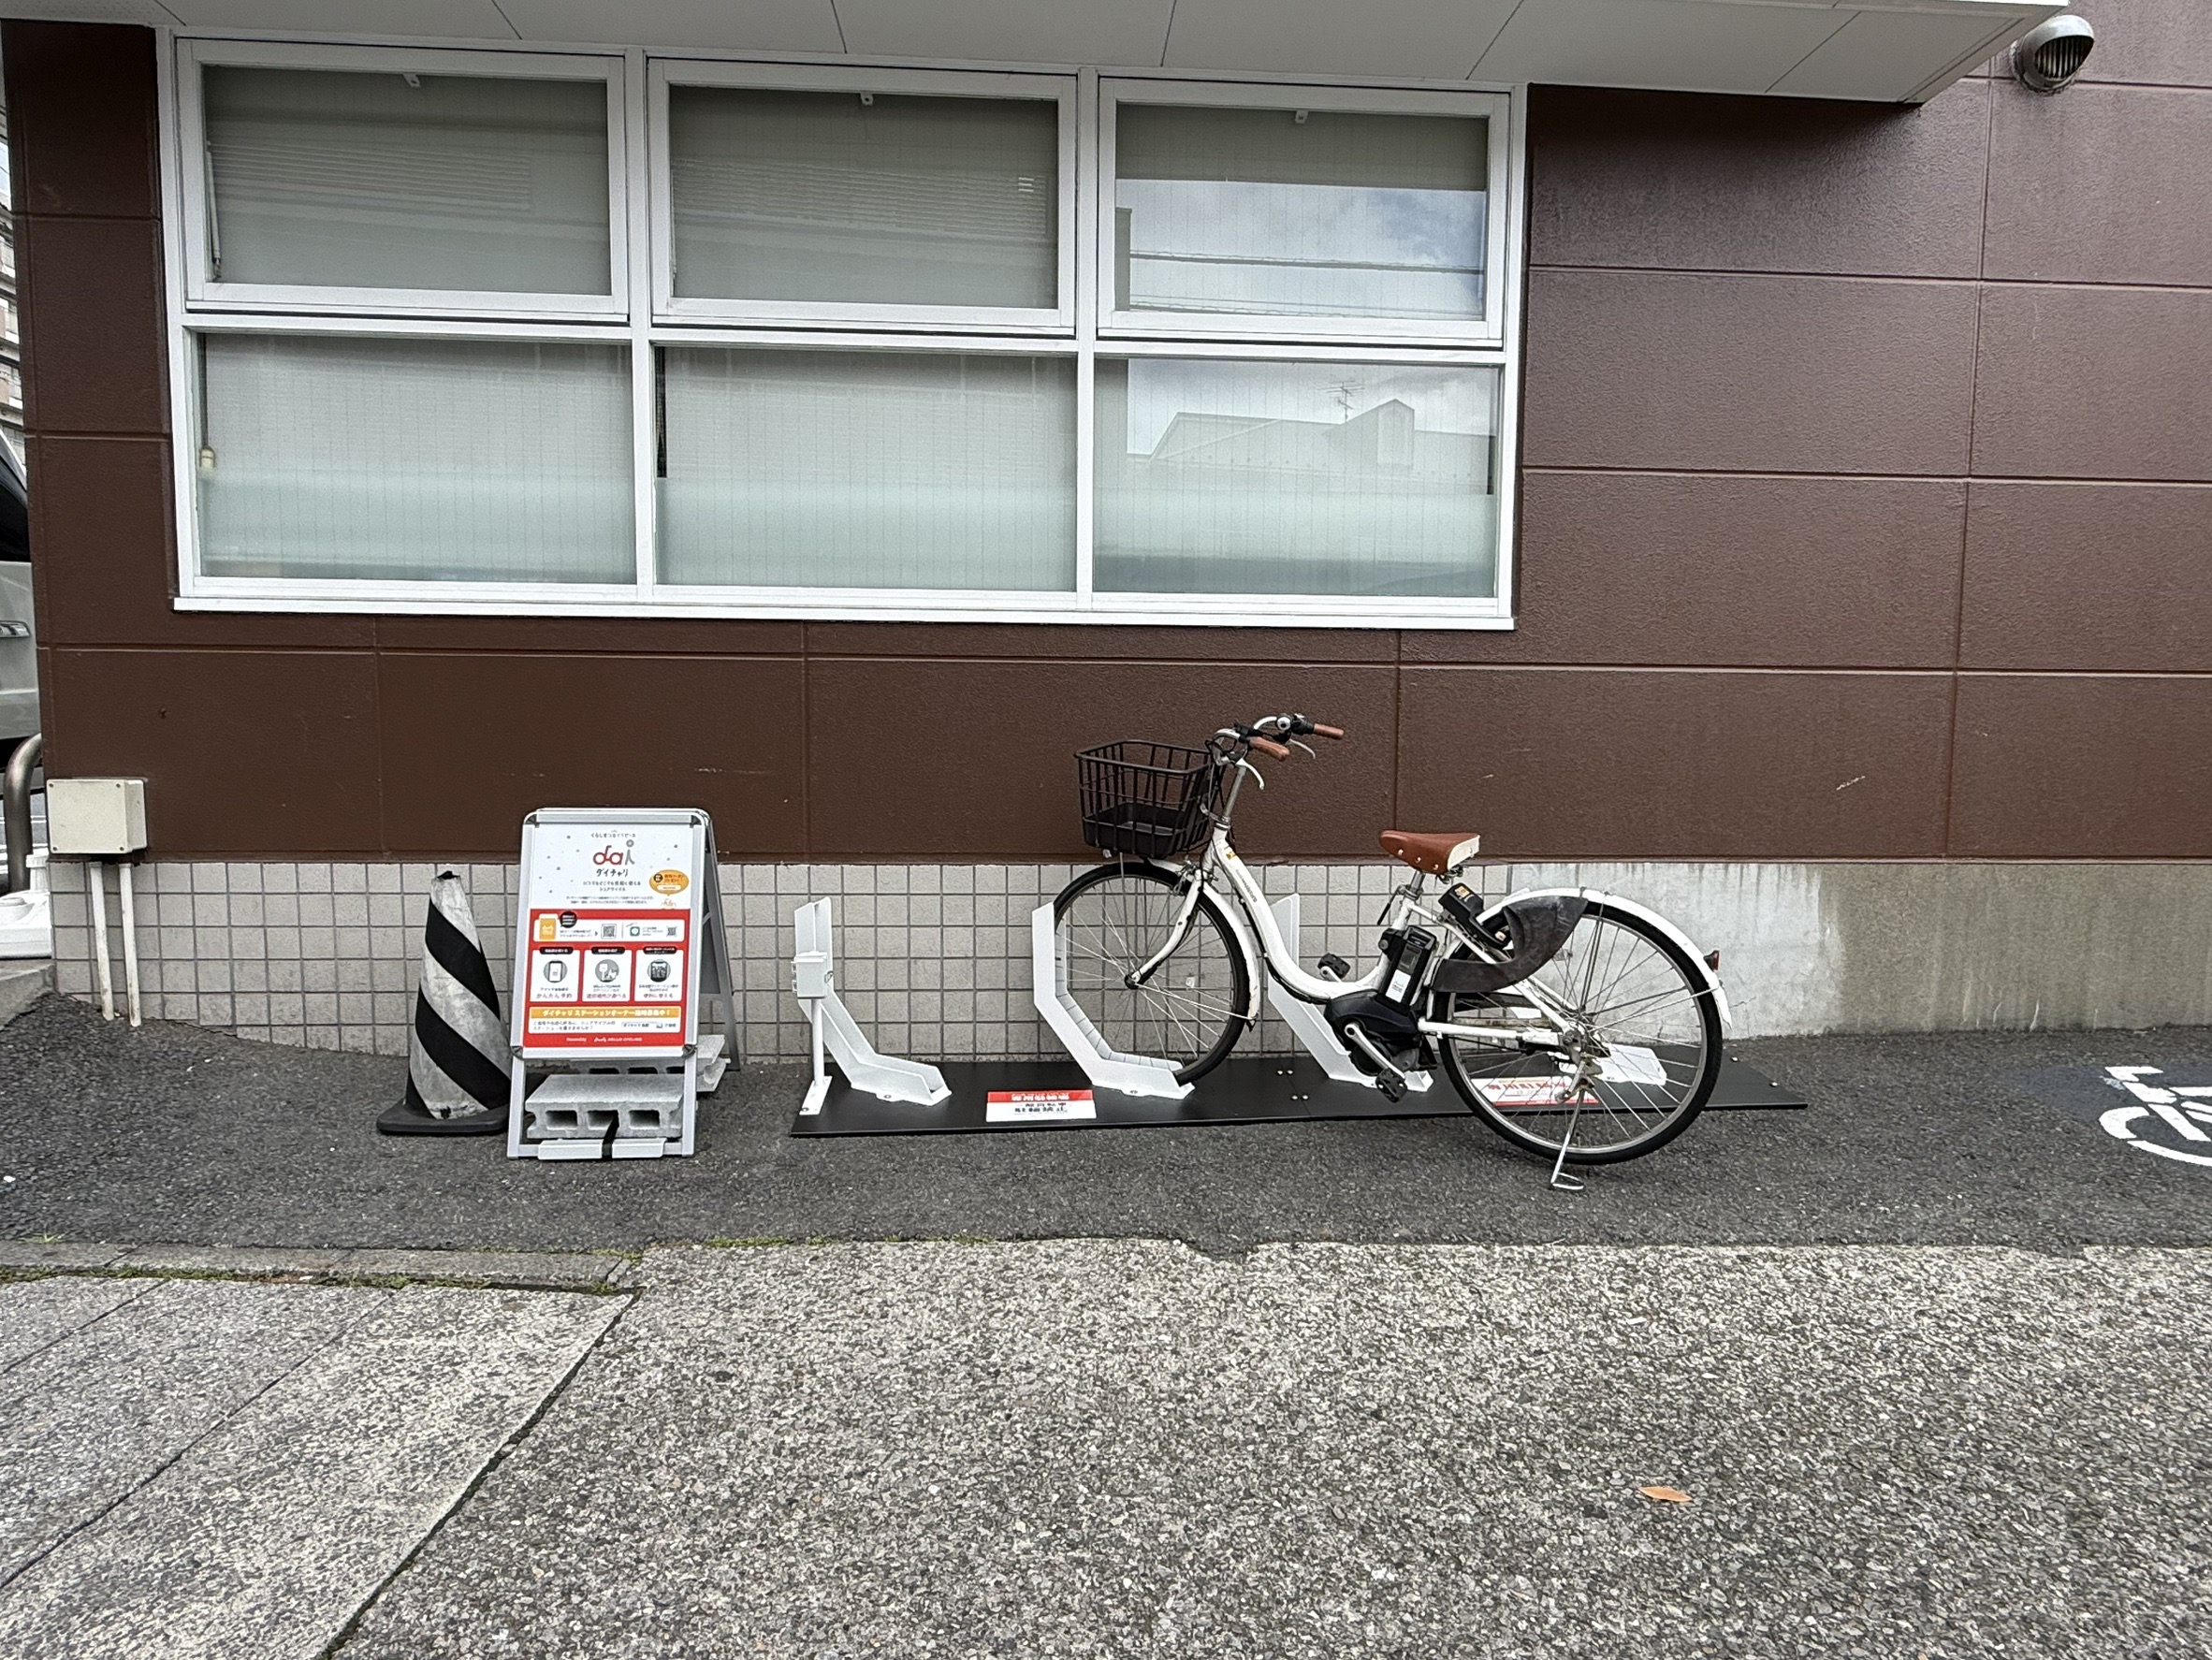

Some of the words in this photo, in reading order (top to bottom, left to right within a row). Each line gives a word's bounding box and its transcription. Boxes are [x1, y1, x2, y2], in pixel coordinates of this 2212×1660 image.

[596, 868, 629, 878] ダイチャリ
